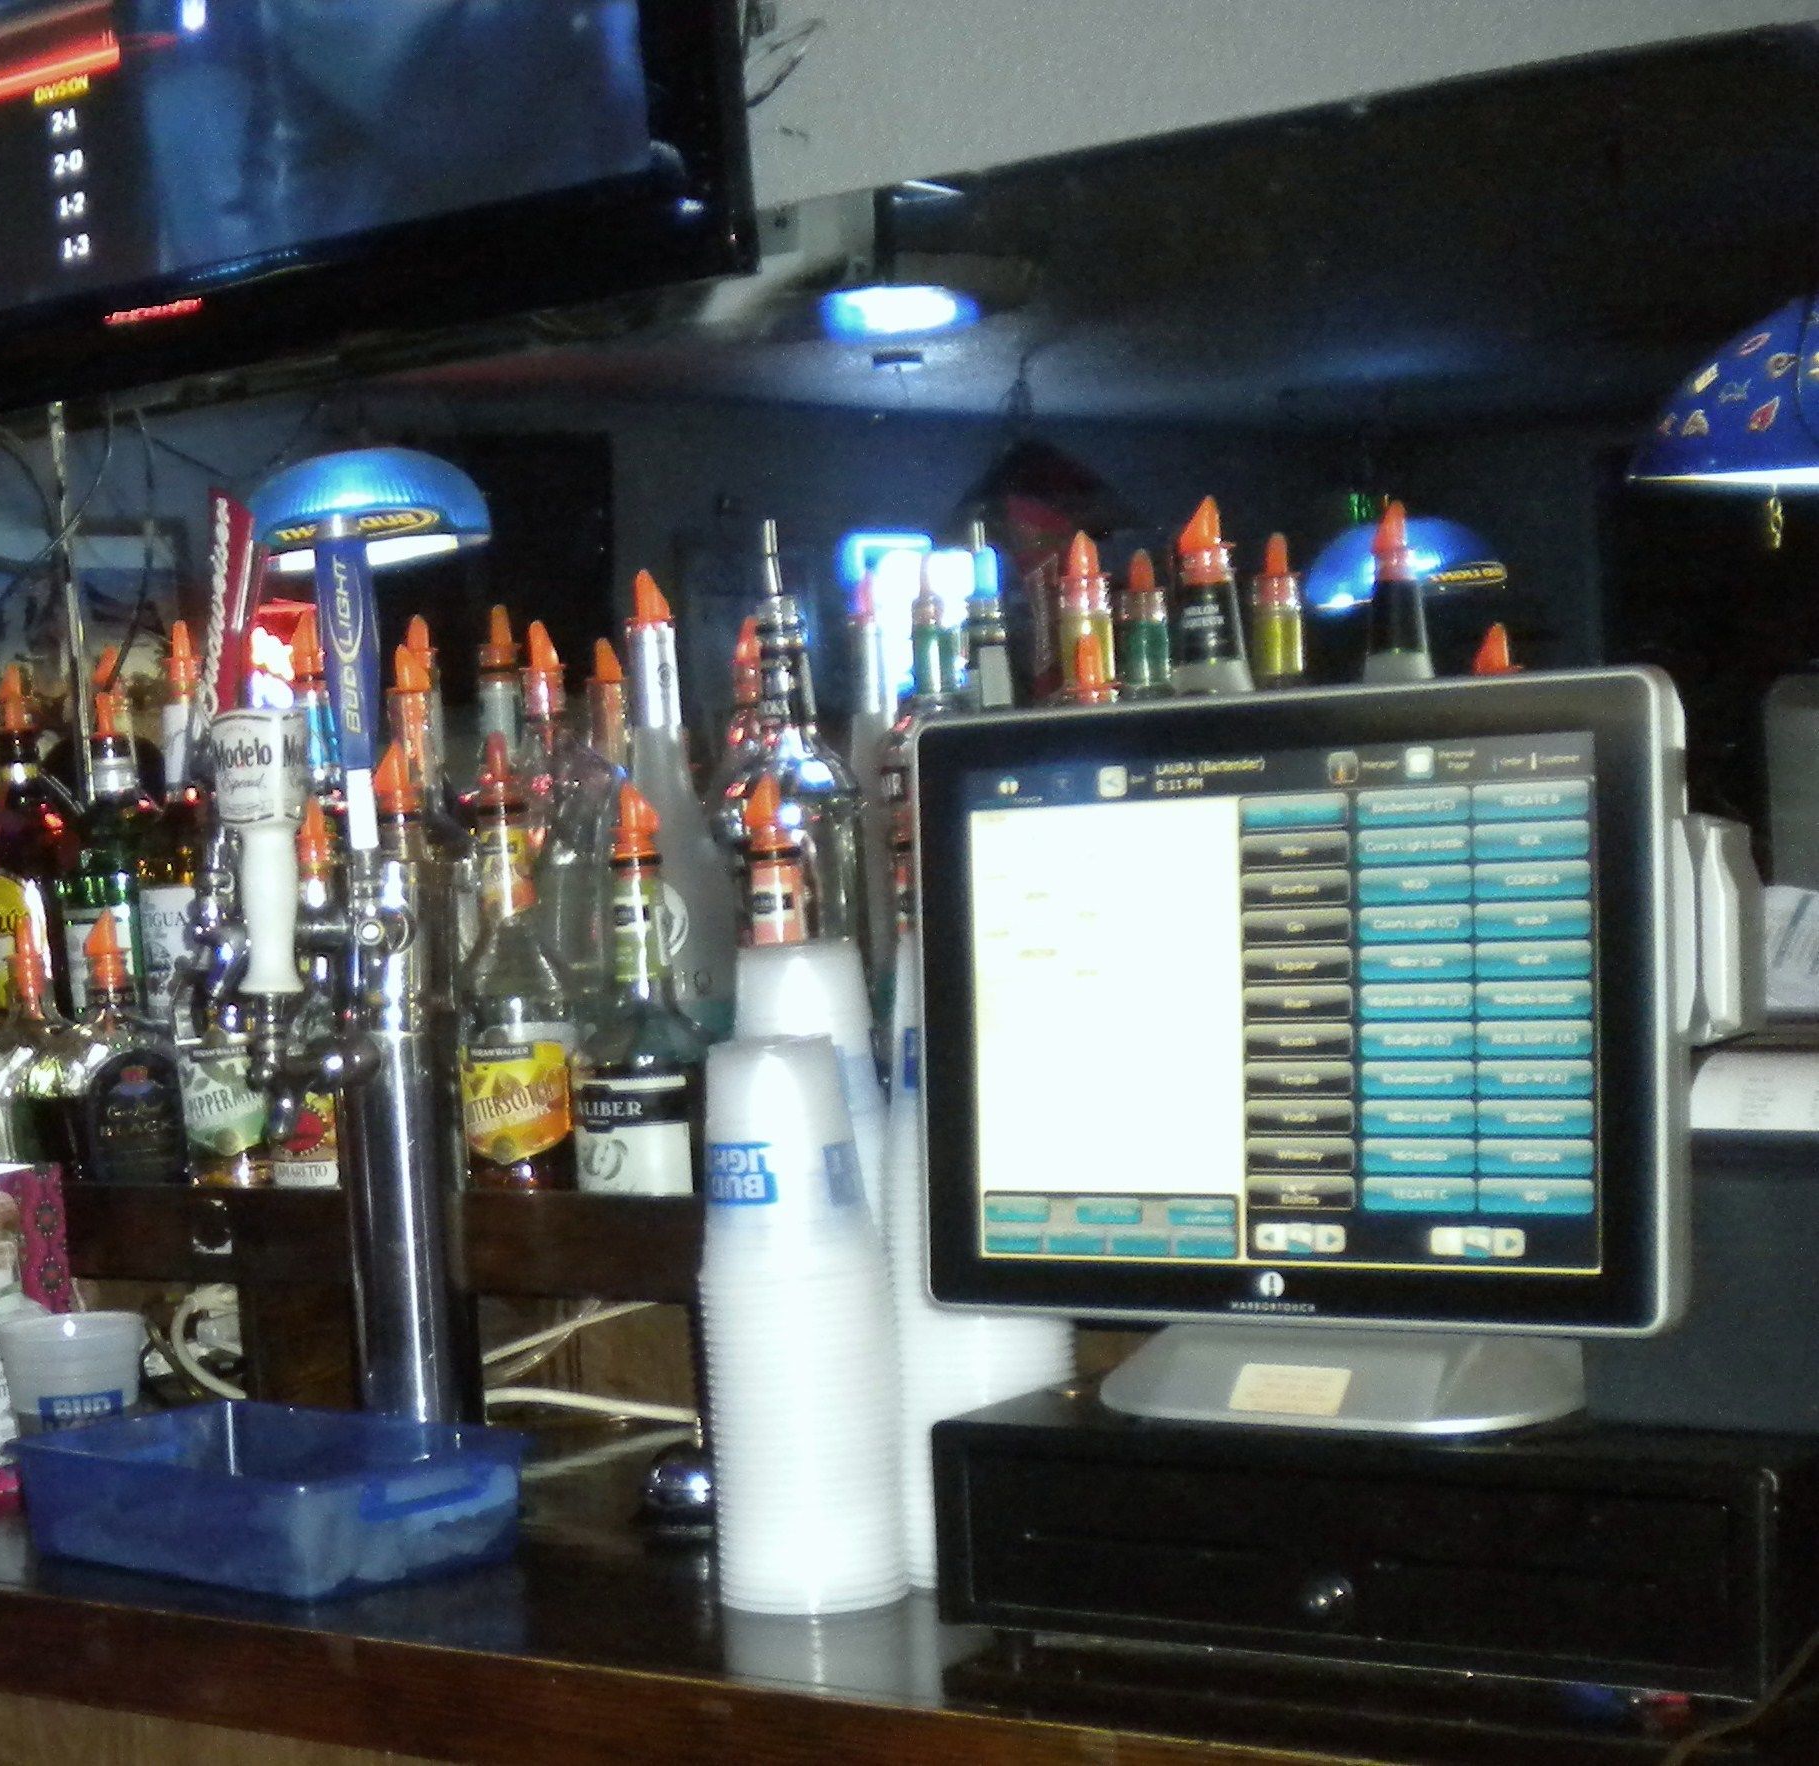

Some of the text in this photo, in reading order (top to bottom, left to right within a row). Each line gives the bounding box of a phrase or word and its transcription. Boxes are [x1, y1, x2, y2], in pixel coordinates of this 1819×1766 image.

[34, 74, 90, 104] DIVISION
[52, 107, 77, 133] 2-1
[54, 148, 84, 176] 2-0
[59, 190, 86, 217] 1-2
[62, 233, 90, 259] 1-3
[332, 553, 362, 734] BUD LIGHT
[213, 736, 272, 769] Modelo
[1155, 760, 1195, 776] LAURA
